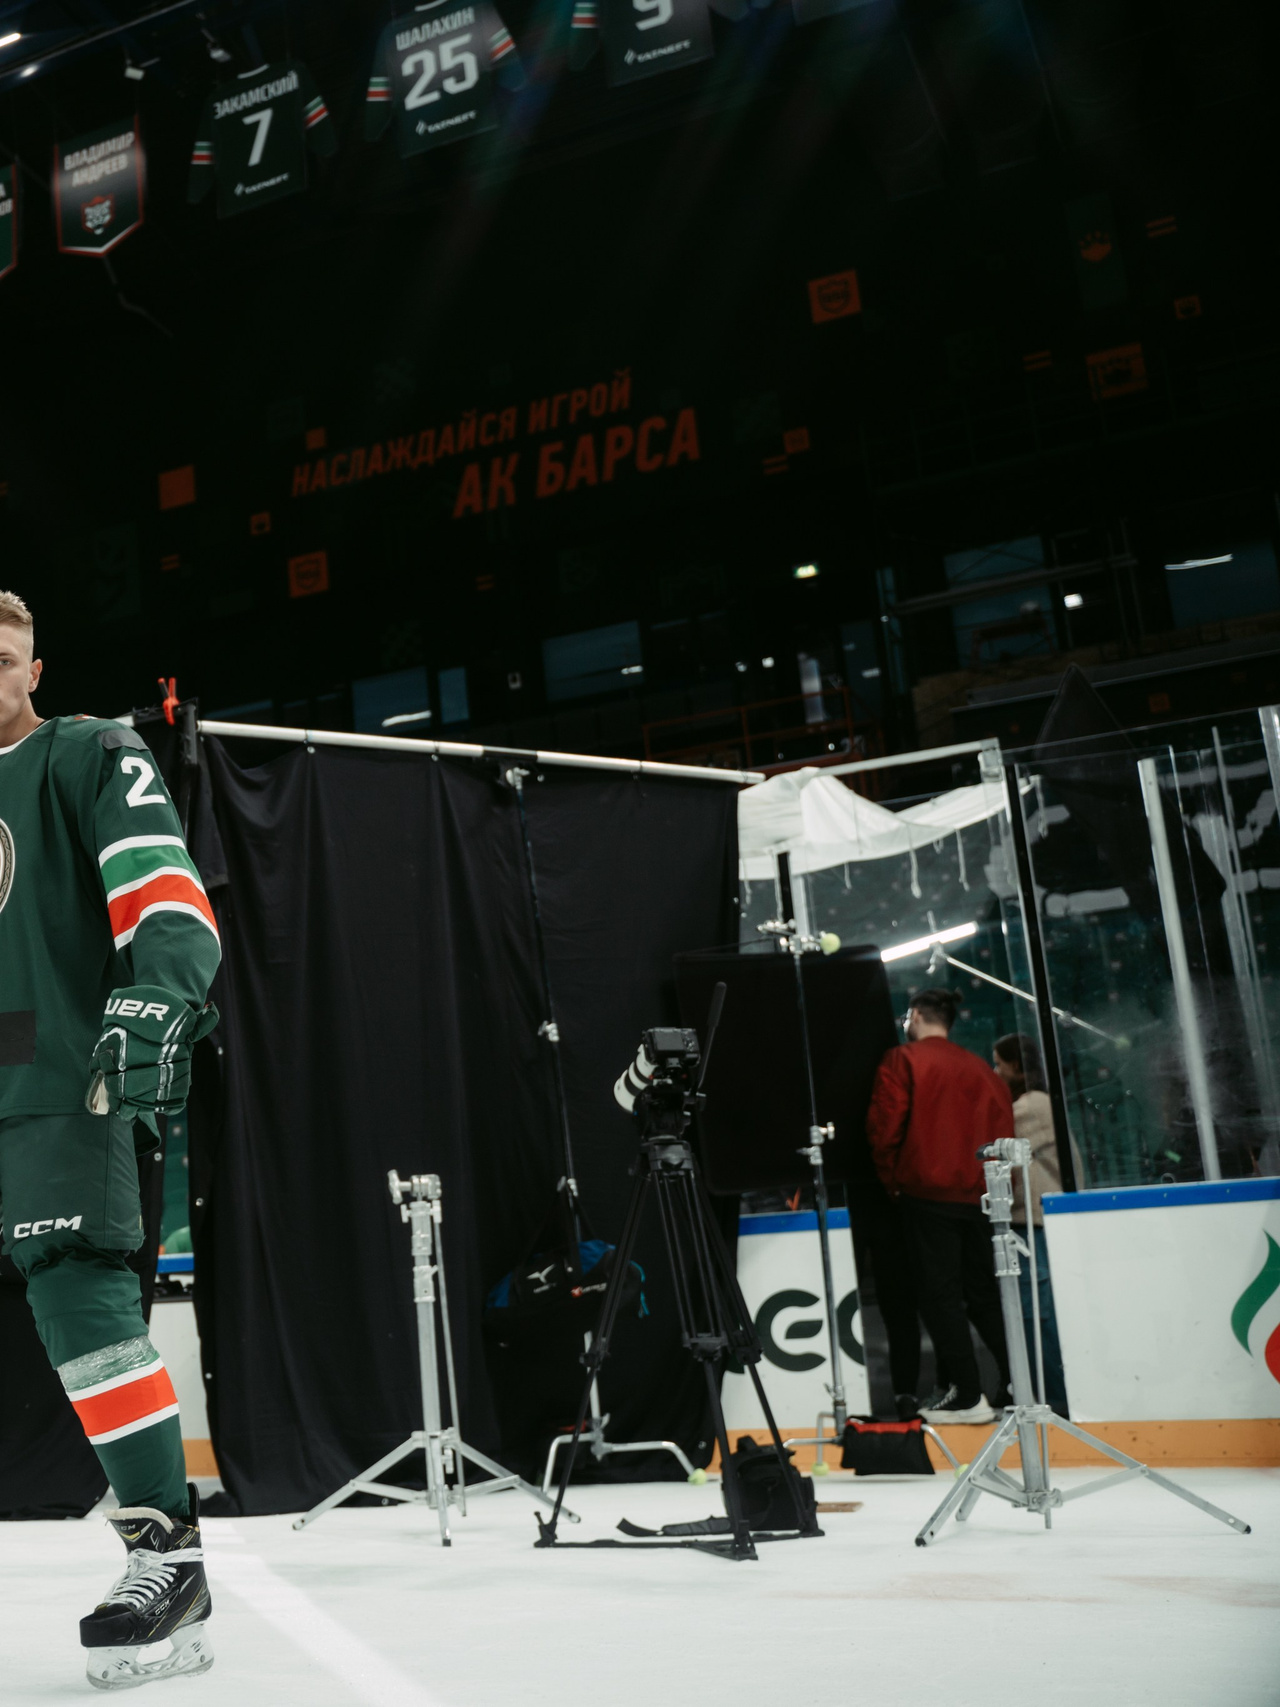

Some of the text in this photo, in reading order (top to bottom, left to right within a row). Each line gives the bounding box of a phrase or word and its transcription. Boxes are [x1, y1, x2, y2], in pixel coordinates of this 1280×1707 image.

[395, 6, 476, 51] ШАЛАХИН
[212, 69, 299, 120] ЗАКАМСКИЙ
[401, 33, 480, 111] 25
[241, 107, 274, 167] 7
[291, 366, 633, 498] НАСЛАЖДАЙСЯ ИГРОЙ
[451, 405, 702, 520] АК БАРСА
[120, 756, 167, 808] 2
[13, 1215, 83, 1239] CCM
